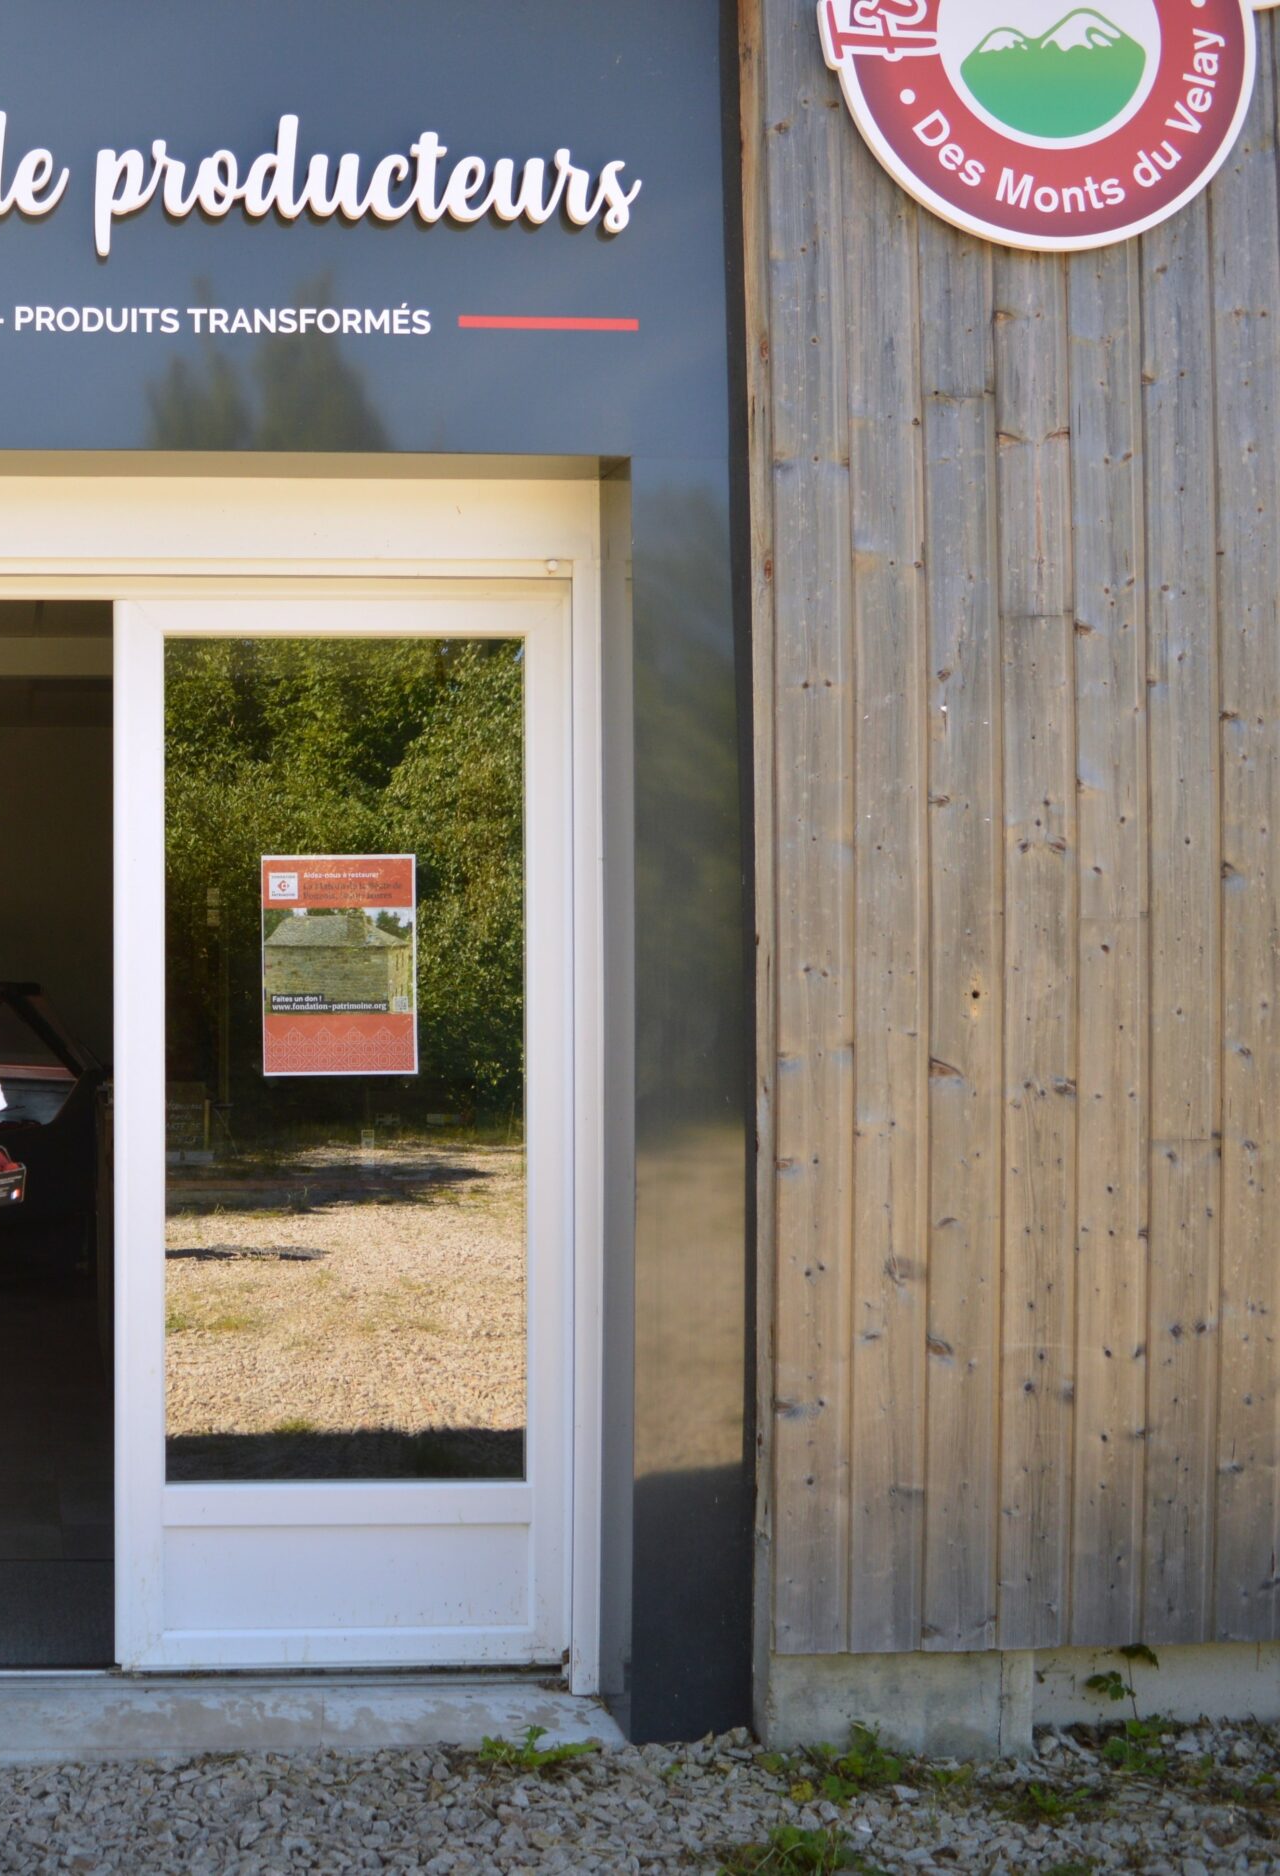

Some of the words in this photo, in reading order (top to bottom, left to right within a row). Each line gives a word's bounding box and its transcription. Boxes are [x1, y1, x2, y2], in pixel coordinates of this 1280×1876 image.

[912, 109, 986, 187] Des
[995, 167, 1126, 213] Monts
[1133, 140, 1182, 188] du
[1165, 28, 1225, 134] Velay
[94, 113, 642, 257] producteurs
[14, 305, 180, 334] PRODUITS
[186, 302, 432, 335] TRANSFORMÉS
[272, 995, 293, 1003] Faites
[272, 1001, 387, 1012] www.fondation-patrimoine.org
